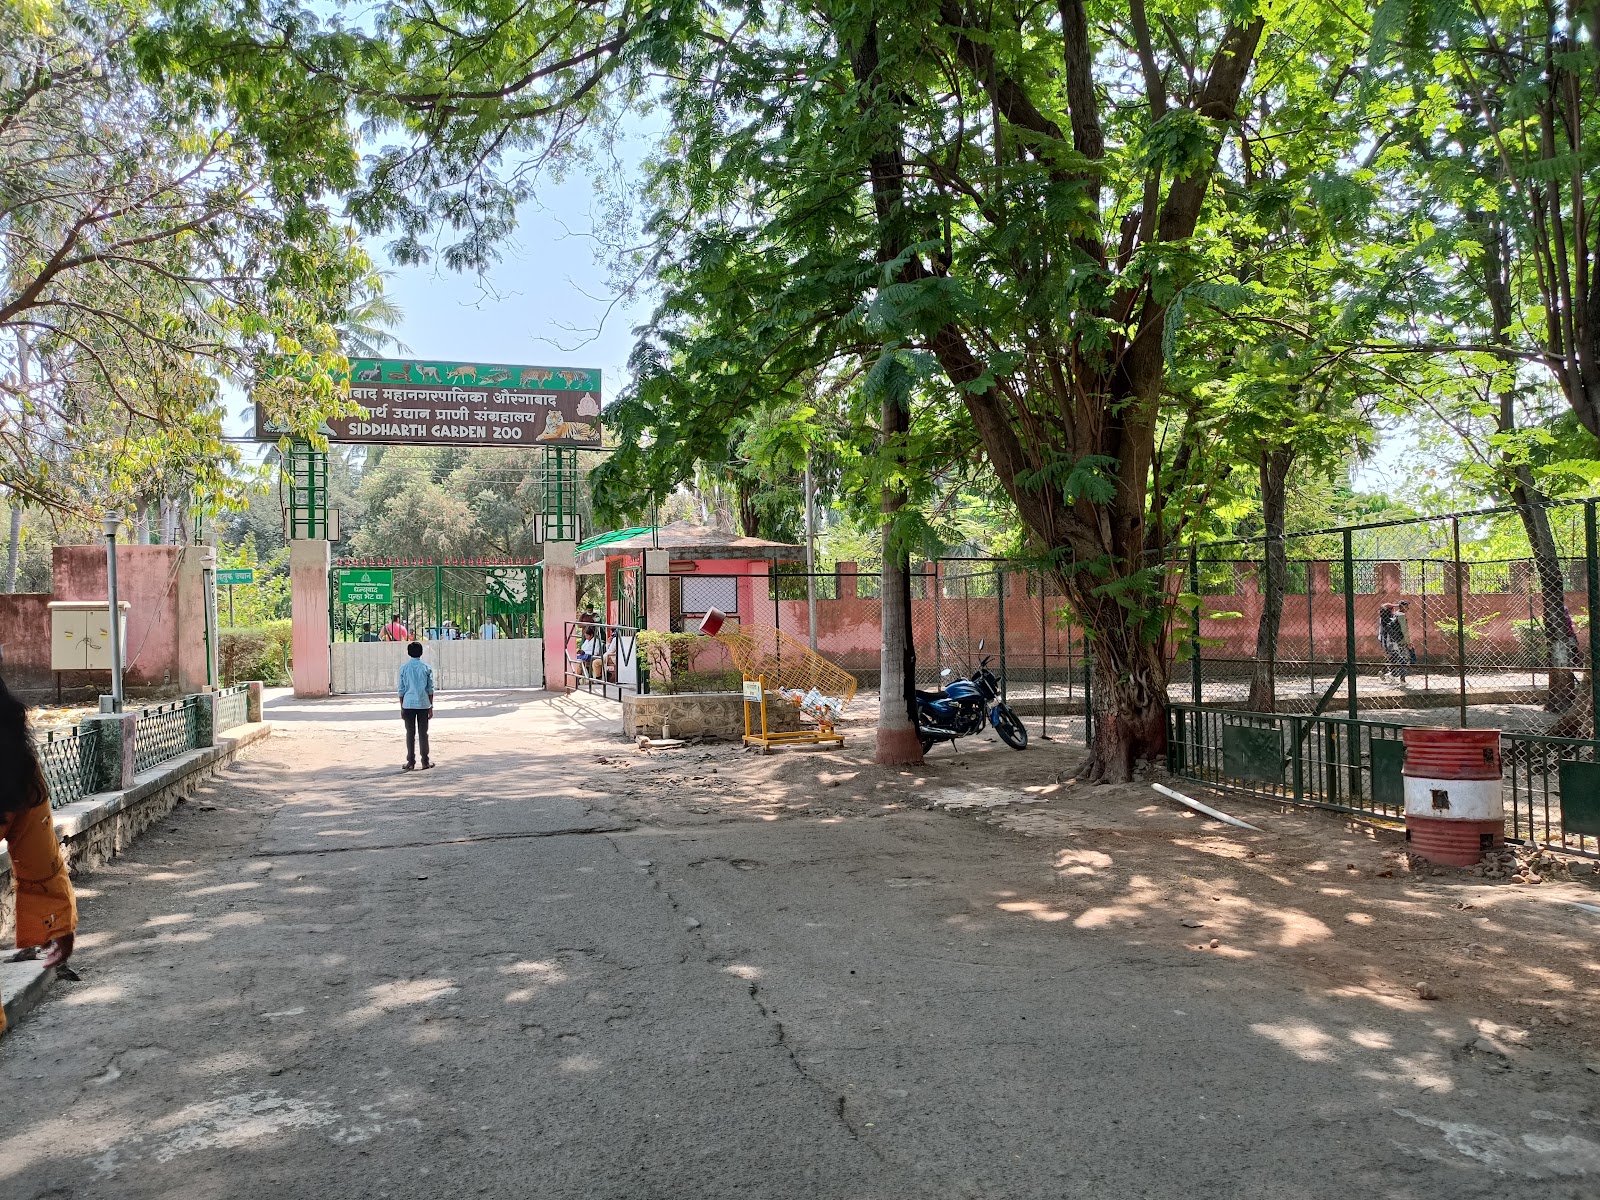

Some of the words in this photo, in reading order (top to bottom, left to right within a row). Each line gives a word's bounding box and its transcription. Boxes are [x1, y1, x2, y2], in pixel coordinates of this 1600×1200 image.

[382, 386, 488, 403] महानगरपालिका
[493, 388, 557, 407] औरंगाबाद
[392, 408, 431, 420] उद्यान
[435, 406, 470, 421] प्राणी
[474, 406, 536, 423] संग्रहालय
[348, 422, 427, 437] SIDDHARTH
[431, 424, 486, 438] GARDEN
[493, 426, 522, 439] ZOO
